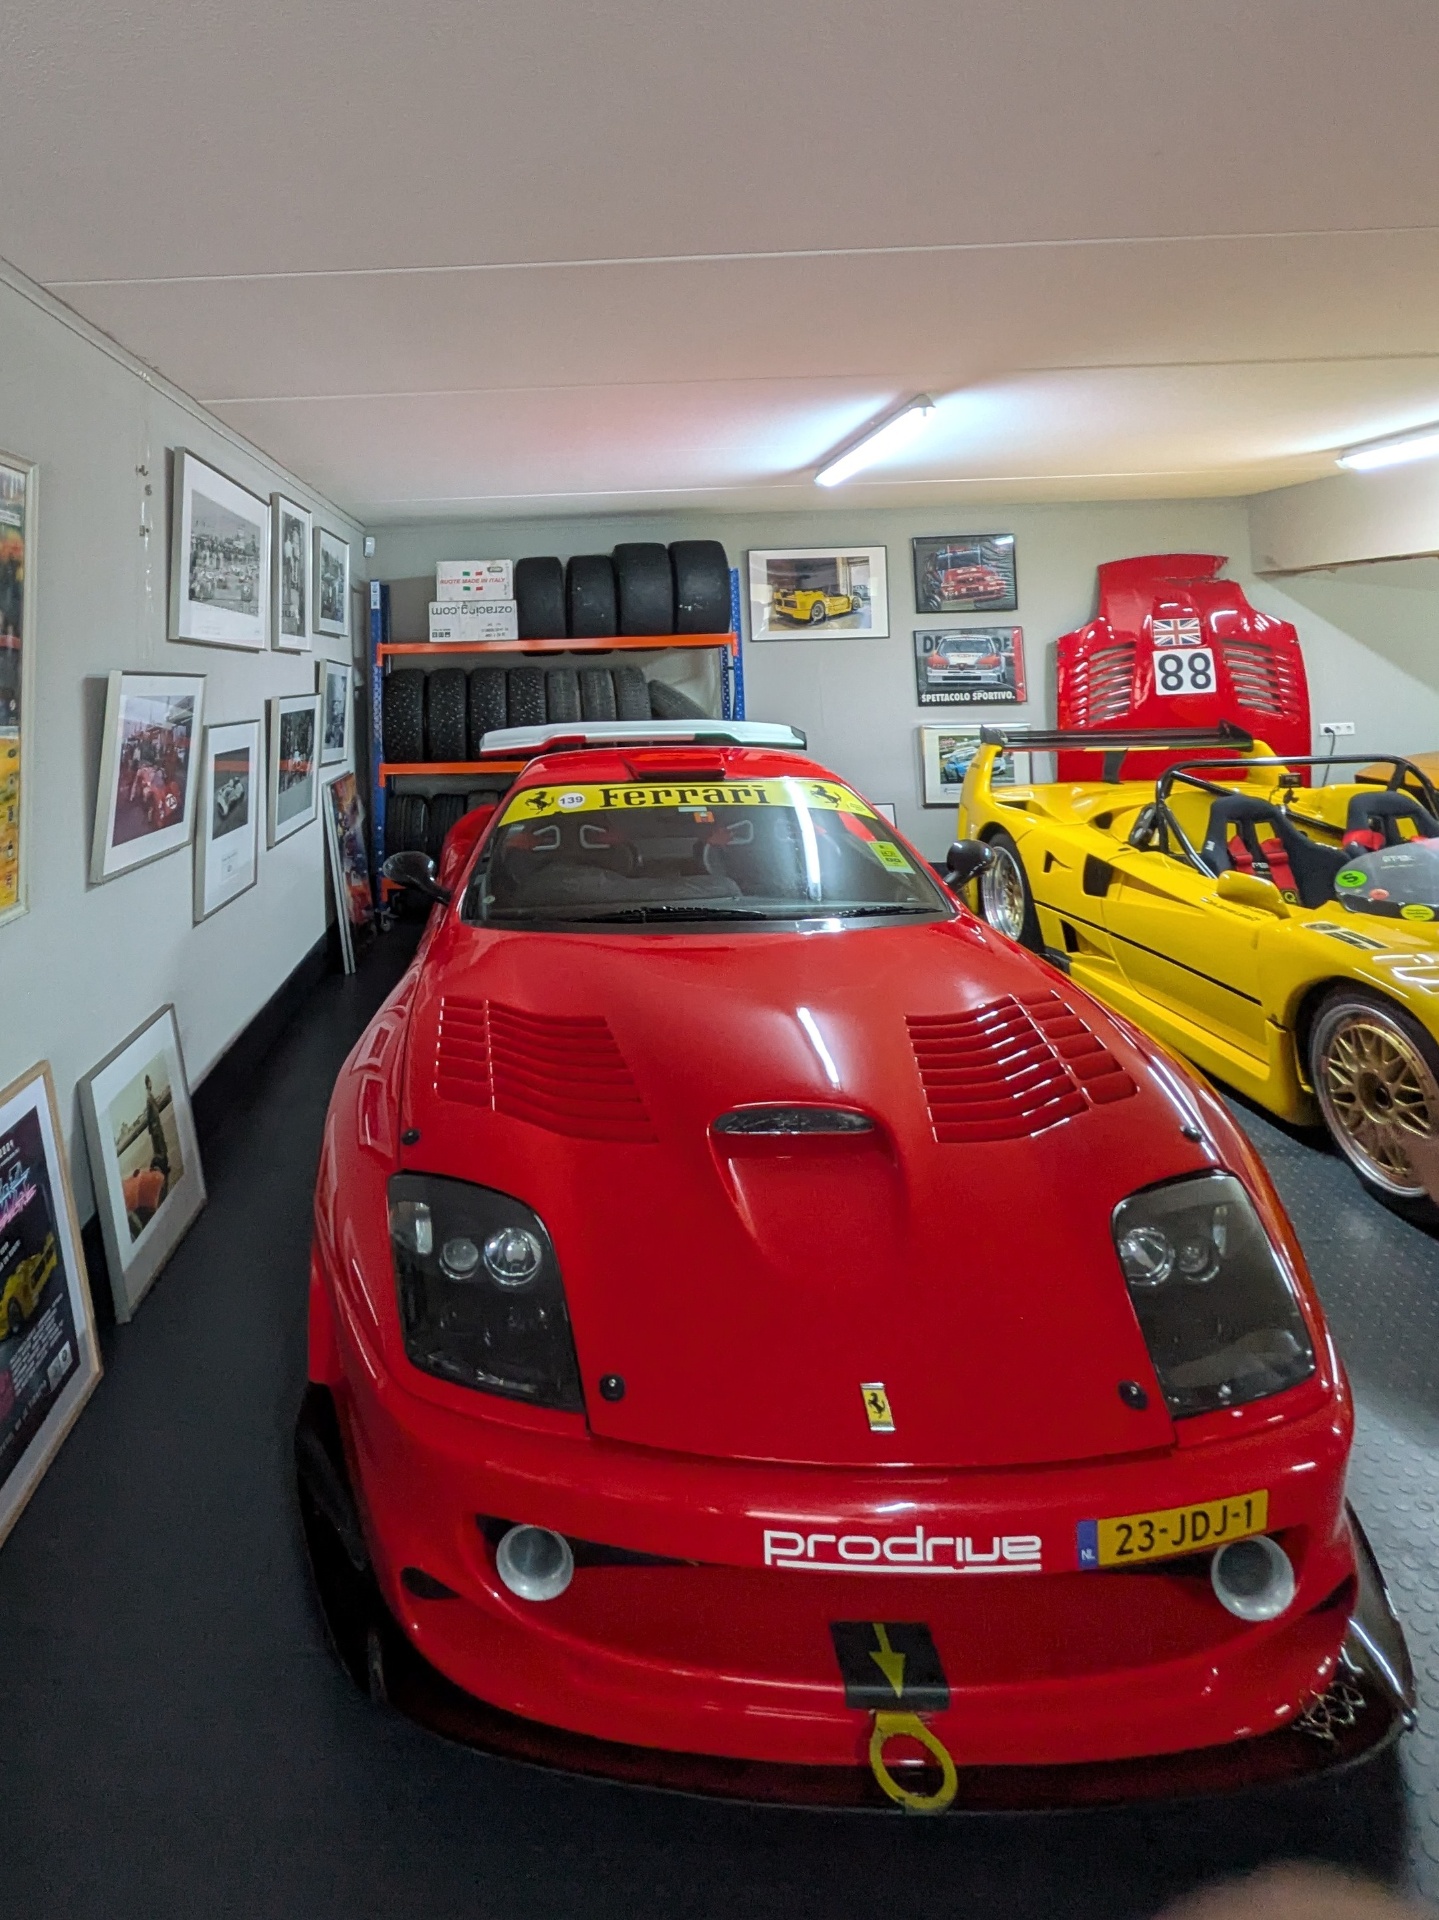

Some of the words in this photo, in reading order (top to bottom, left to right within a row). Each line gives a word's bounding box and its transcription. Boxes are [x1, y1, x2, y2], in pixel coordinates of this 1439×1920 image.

[432, 605, 512, 616] ozracing.com
[1158, 652, 1212, 691] 88
[921, 692, 971, 703] SPETTACOLO
[972, 690, 1016, 701] SPORTIVO.
[559, 795, 584, 805] 139
[599, 783, 771, 808] Ferrari
[1080, 1548, 1096, 1561] NL
[1114, 1498, 1253, 1557] 23-JDJ-1
[763, 1525, 1042, 1573] prodrive
